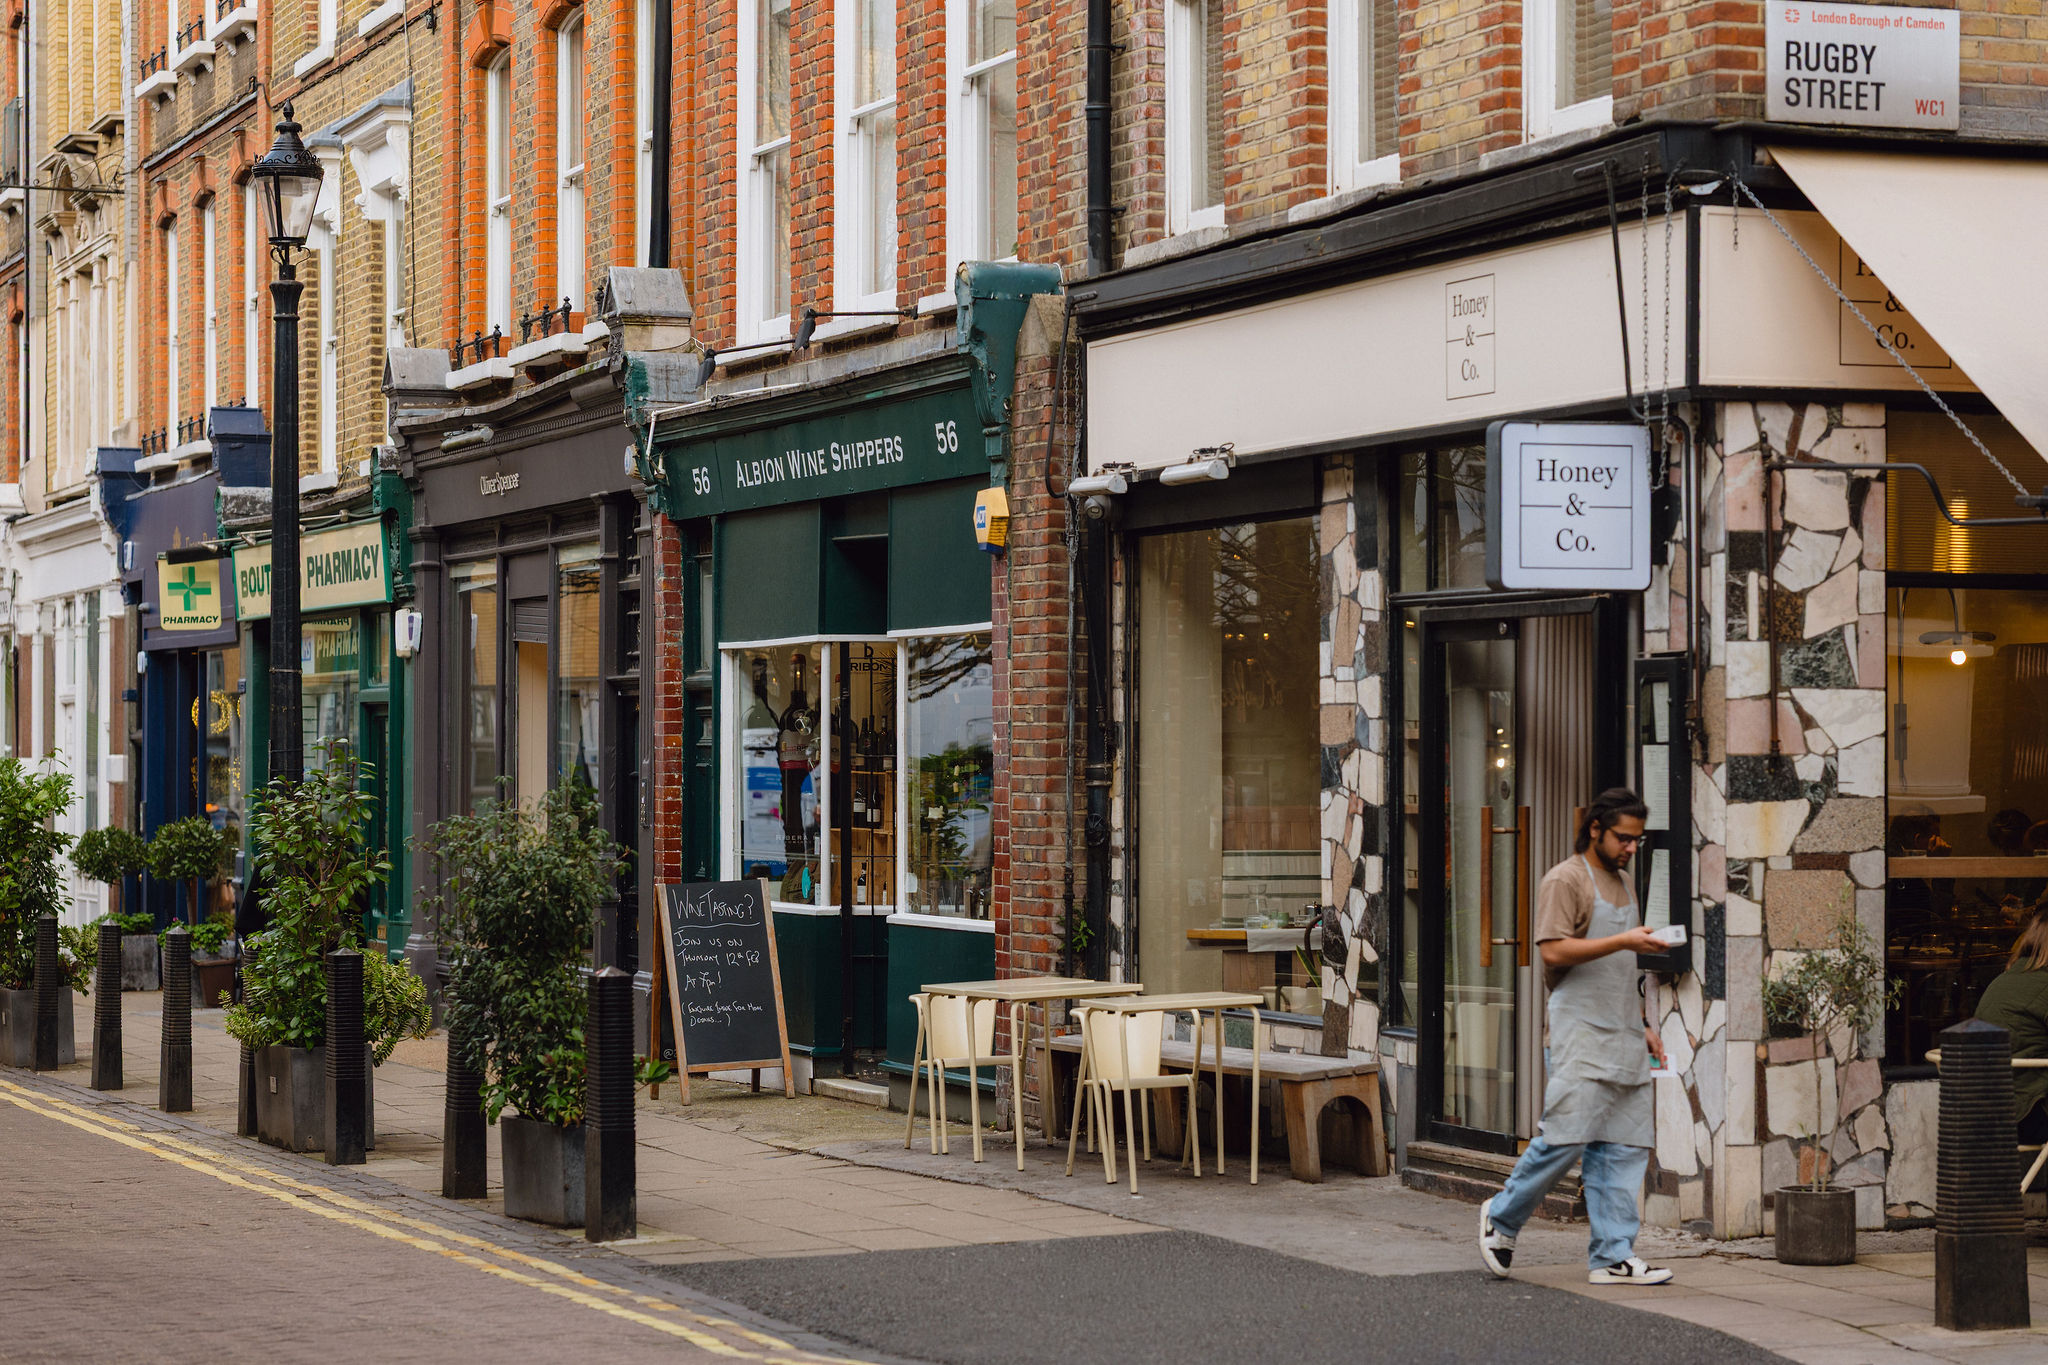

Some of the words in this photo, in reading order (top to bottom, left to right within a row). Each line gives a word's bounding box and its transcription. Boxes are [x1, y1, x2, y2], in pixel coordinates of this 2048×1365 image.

[1811, 10, 1847, 25] London
[1850, 13, 1890, 30] Borough
[1894, 16, 1903, 28] of
[1906, 17, 1945, 30] Camden
[1785, 40, 1877, 75] RUGBY
[1785, 77, 1886, 112] STREET
[1915, 98, 1945, 117] WC1
[1452, 294, 1489, 318] Honey
[1465, 324, 1476, 347] &
[1875, 324, 1915, 349] Co.
[1461, 358, 1480, 381] Co.
[934, 420, 959, 455] 56
[736, 456, 786, 489] ALBION
[786, 448, 828, 480] WINE
[830, 435, 904, 472] SHIPPERS
[692, 466, 711, 496] 56
[1536, 459, 1619, 490] Honey
[1566, 493, 1587, 516] &
[1556, 528, 1596, 552] Co.
[306, 544, 379, 588] PHARMACY
[163, 615, 219, 625] PHARMACY
